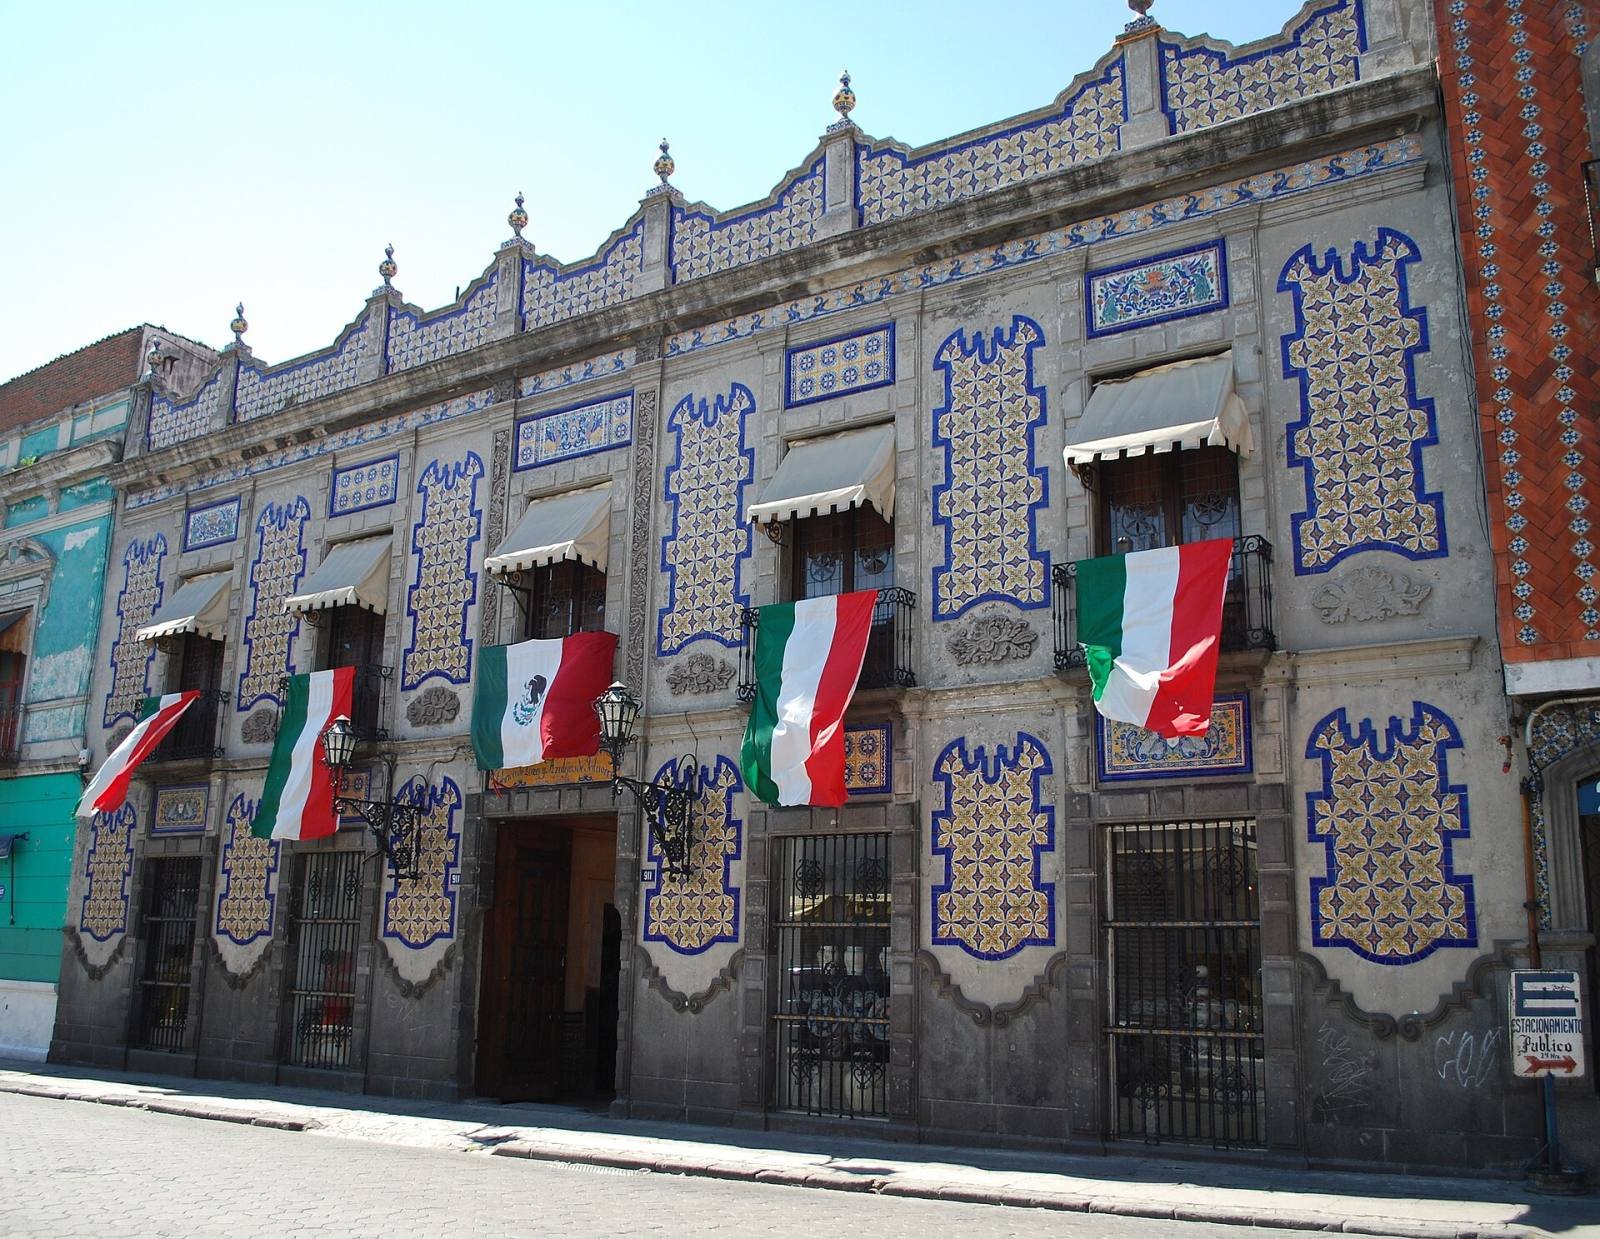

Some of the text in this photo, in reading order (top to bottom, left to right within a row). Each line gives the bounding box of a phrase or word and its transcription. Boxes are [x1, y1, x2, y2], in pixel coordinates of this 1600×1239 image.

[644, 871, 652, 880] 911
[1515, 973, 1576, 1016] E
[1513, 1019, 1583, 1033] ESTACIONAMIENTO
[1518, 1034, 1572, 1055] Publico
